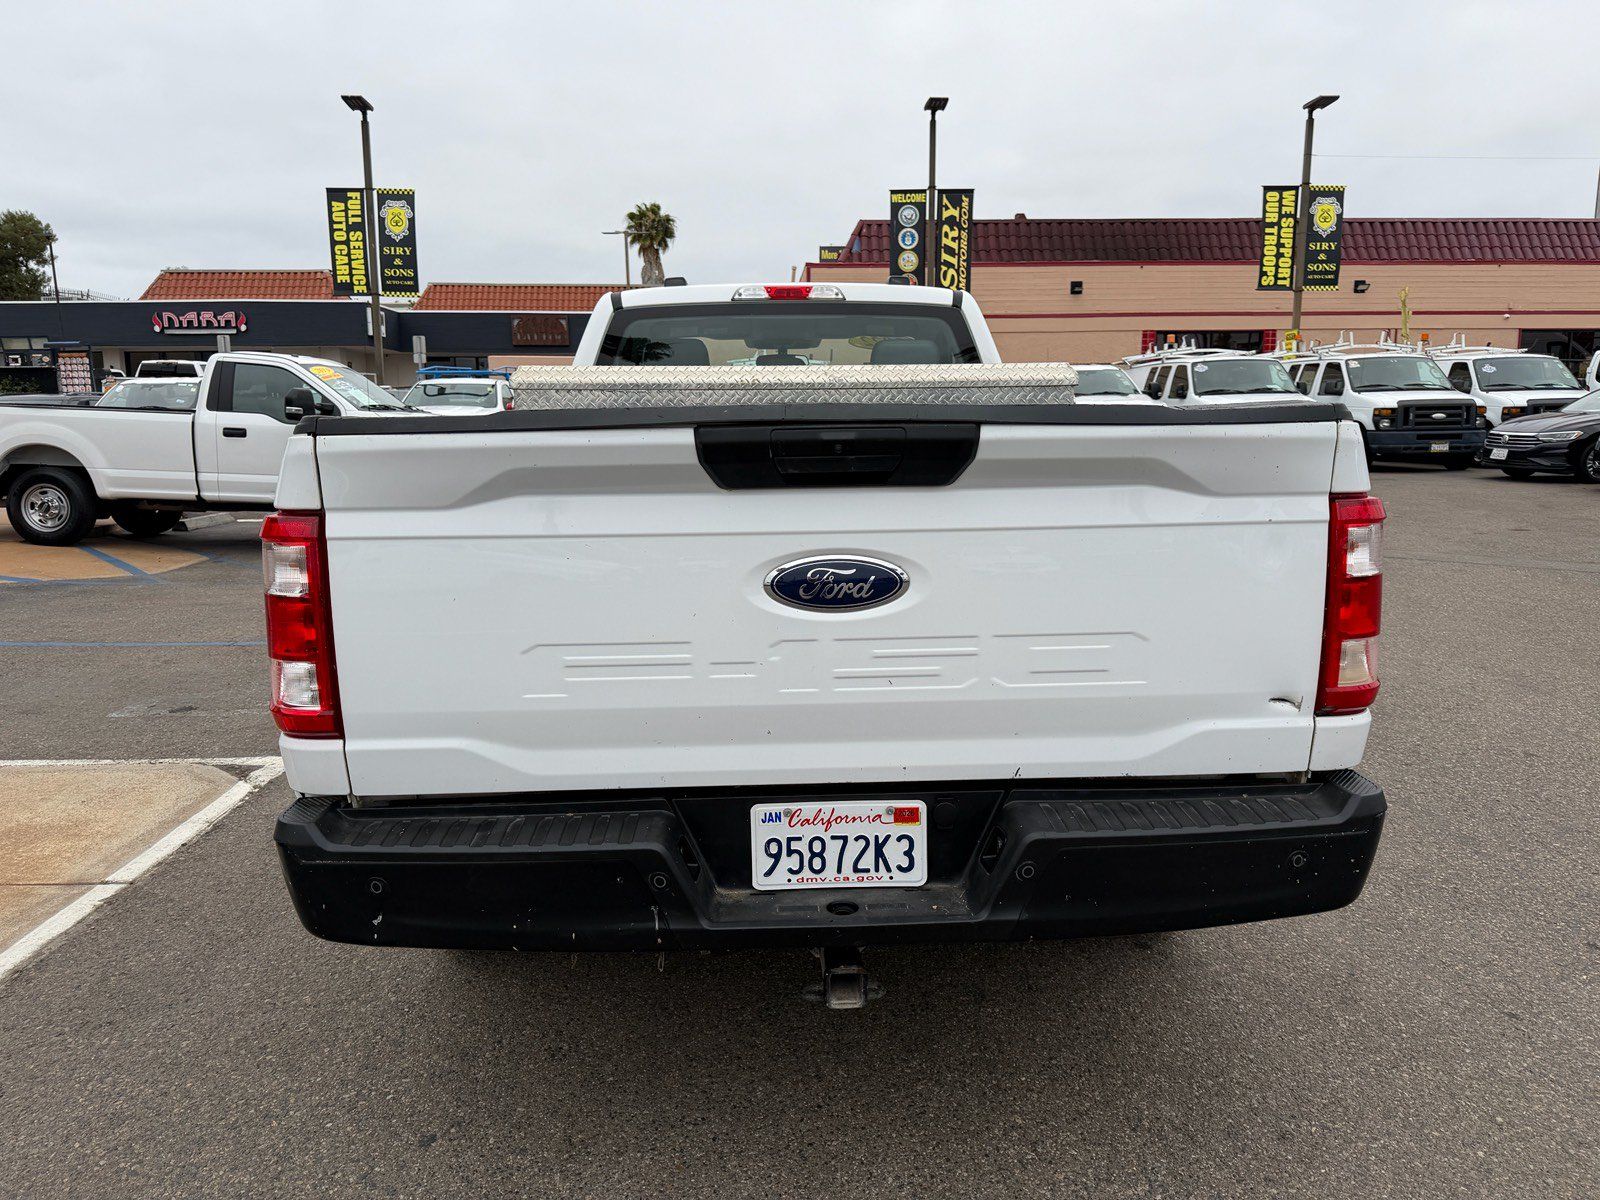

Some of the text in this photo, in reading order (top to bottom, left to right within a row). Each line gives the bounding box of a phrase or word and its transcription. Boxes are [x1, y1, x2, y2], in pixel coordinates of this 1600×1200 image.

[891, 193, 926, 203] WELCOME
[331, 201, 349, 283] AUTO CARE
[347, 192, 367, 293] FULL SERVICE
[940, 194, 959, 291] SIRY
[1261, 191, 1279, 286] OUR TROOPS
[1277, 189, 1296, 287] WE SUPPORT
[1308, 242, 1338, 250] SIRY
[383, 246, 412, 256] SIRY
[1317, 252, 1328, 260] &
[393, 258, 404, 266] &
[1306, 263, 1337, 271] SONS
[384, 268, 414, 277] SONS
[162, 311, 236, 328] NARA
[798, 566, 877, 602] Ford
[761, 811, 782, 824] JAN
[787, 807, 894, 833] California
[763, 833, 915, 878] 95872K3
[796, 875, 884, 884] dmv.ca.gov
